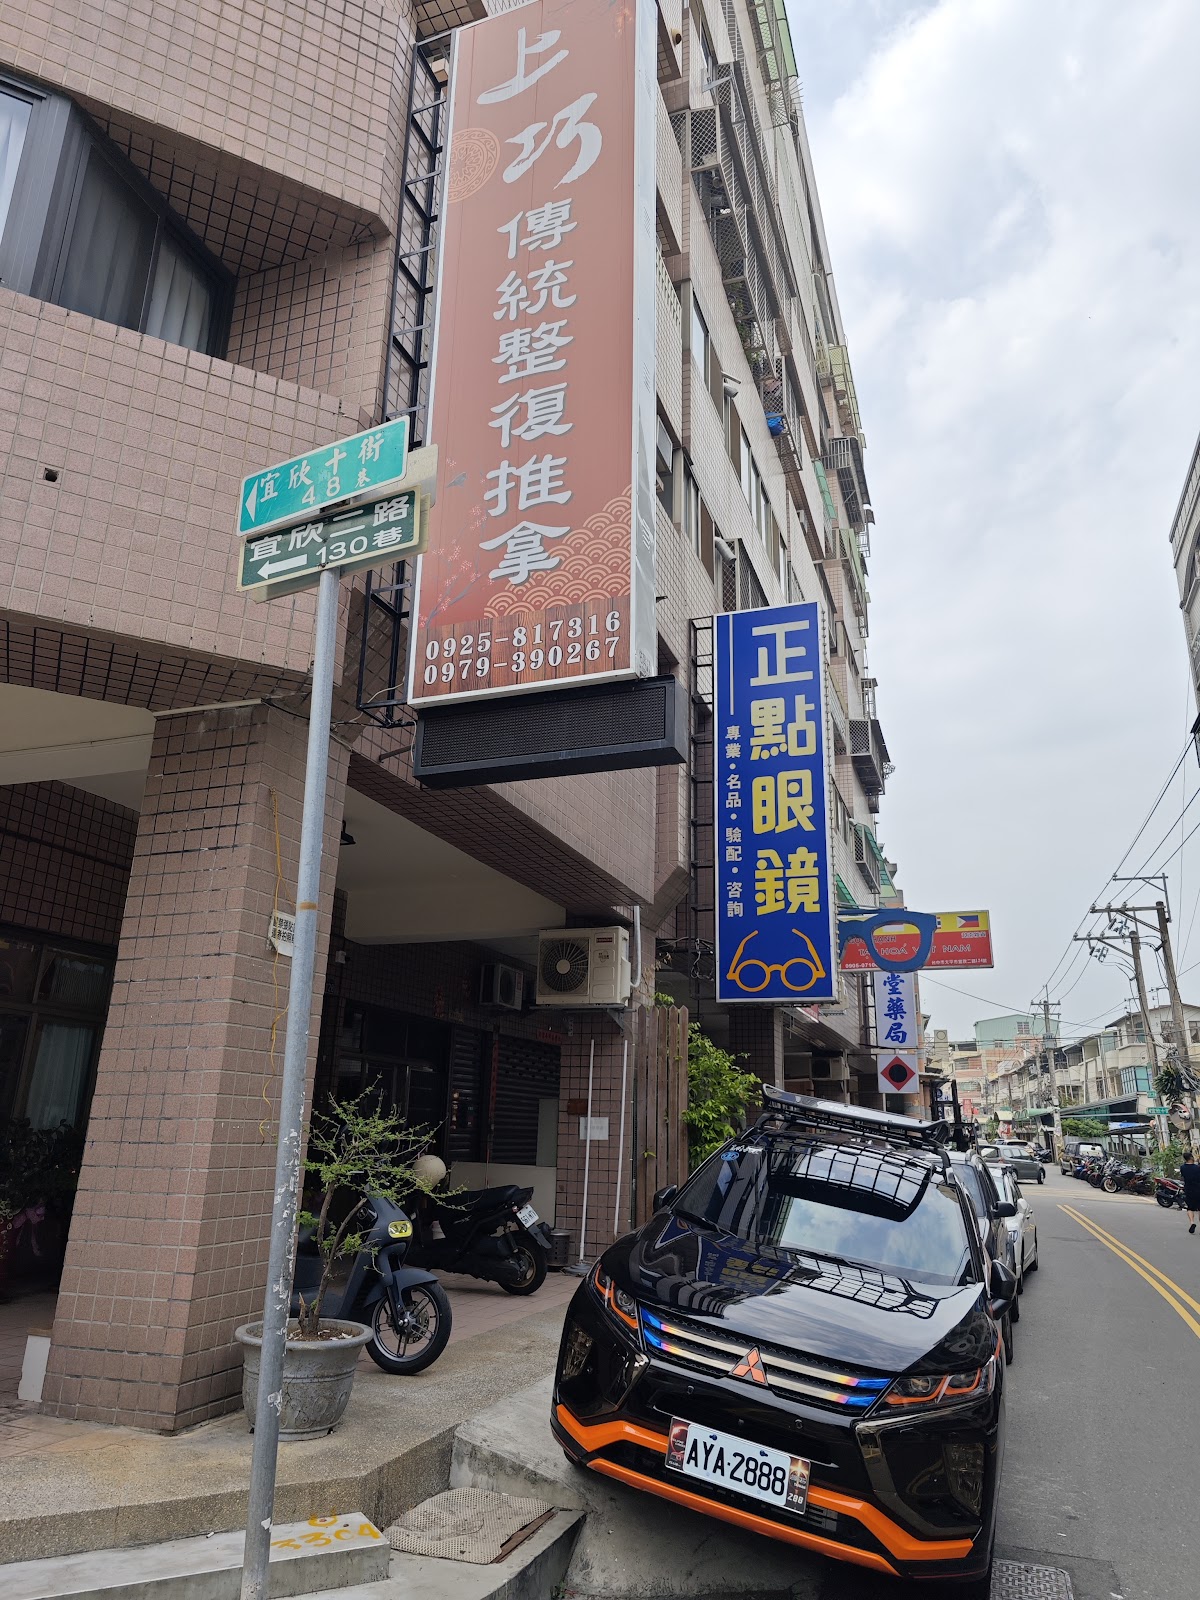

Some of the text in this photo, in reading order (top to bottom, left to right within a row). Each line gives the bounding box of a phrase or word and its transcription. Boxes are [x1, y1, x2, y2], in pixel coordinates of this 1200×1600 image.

[476, 27, 603, 189] 上巧
[479, 198, 578, 585] 傳統整復推拿
[260, 433, 385, 503] 宜欣十街
[249, 495, 410, 562] 宜欣二路
[315, 526, 403, 564] 130巷
[424, 636, 620, 685] 0979-390267
[425, 610, 621, 661] 0925-817316
[750, 620, 820, 916] 正點眼鏡
[942, 943, 971, 953] NAM
[882, 972, 907, 1044] 堂藥局
